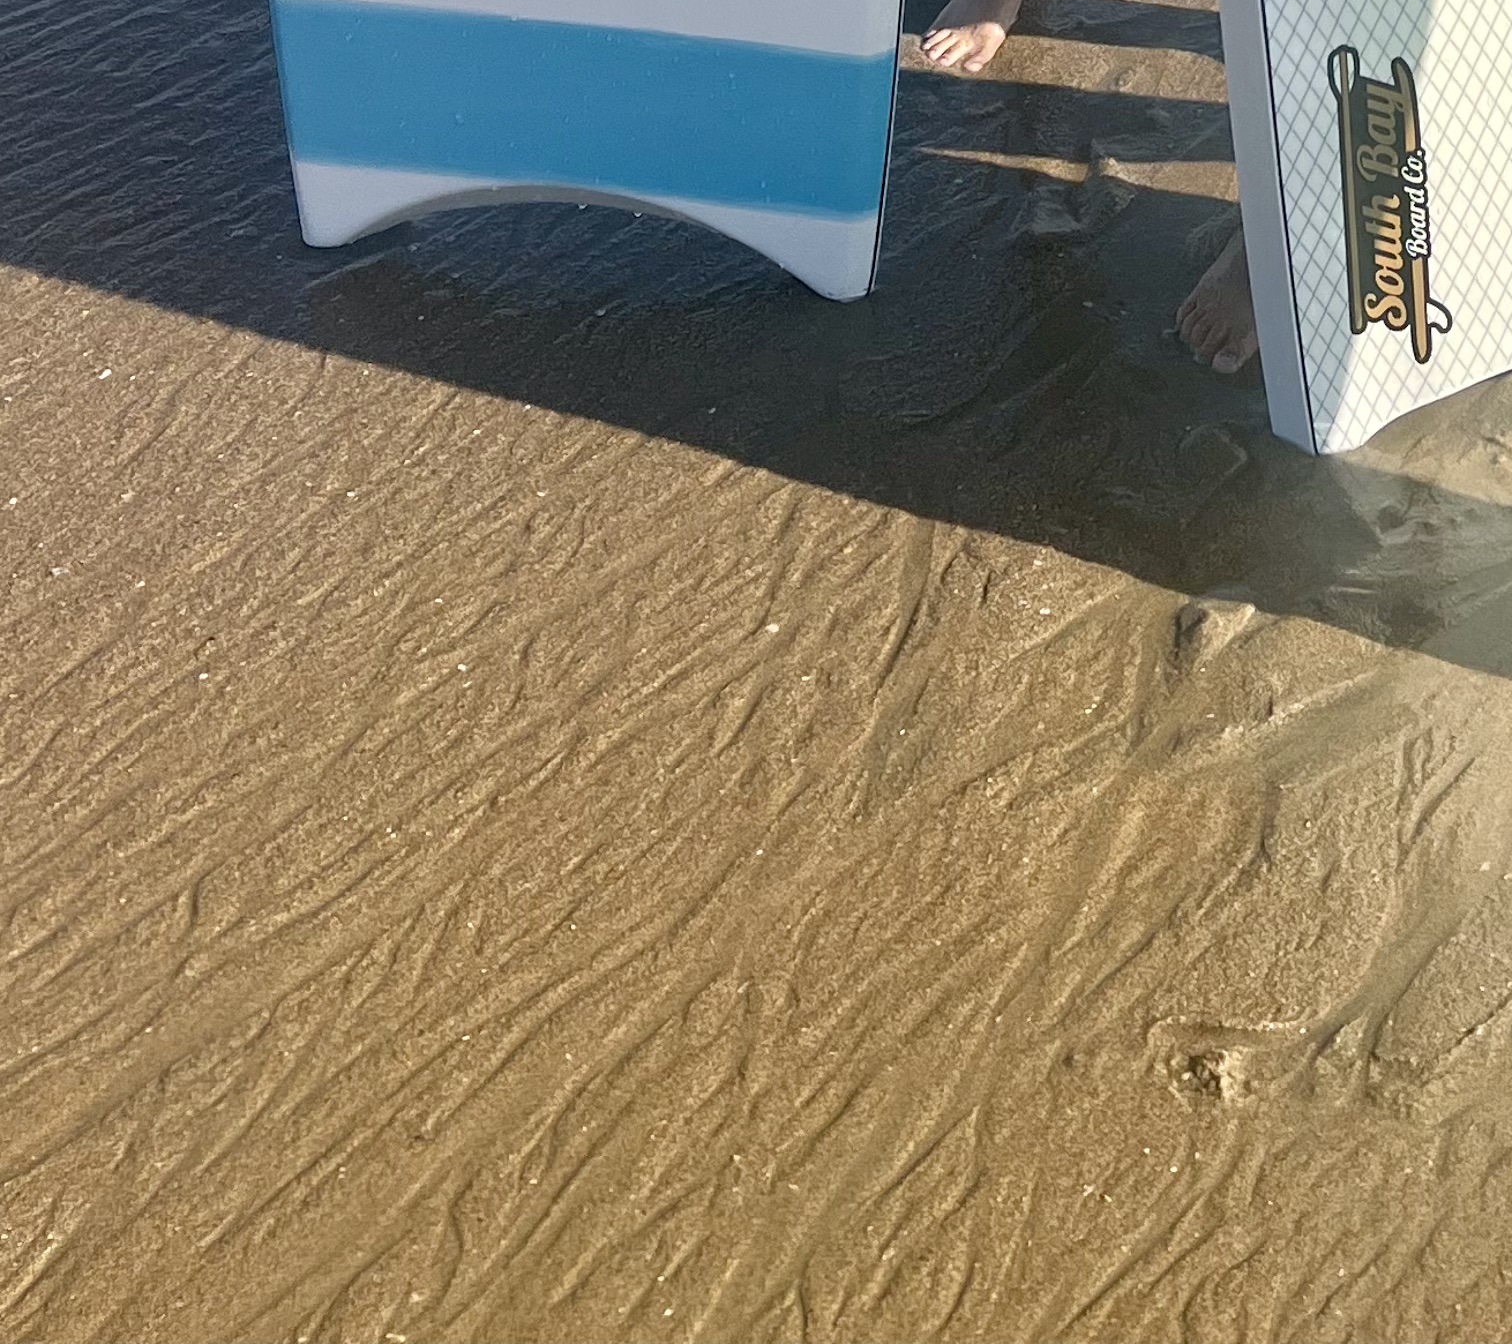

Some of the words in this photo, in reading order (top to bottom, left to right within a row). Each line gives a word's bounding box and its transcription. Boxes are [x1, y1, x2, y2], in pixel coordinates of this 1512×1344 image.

[1357, 83, 1404, 182] Bay
[1402, 149, 1424, 184] Co.
[1362, 194, 1407, 327] South
[1405, 185, 1428, 258] Board
